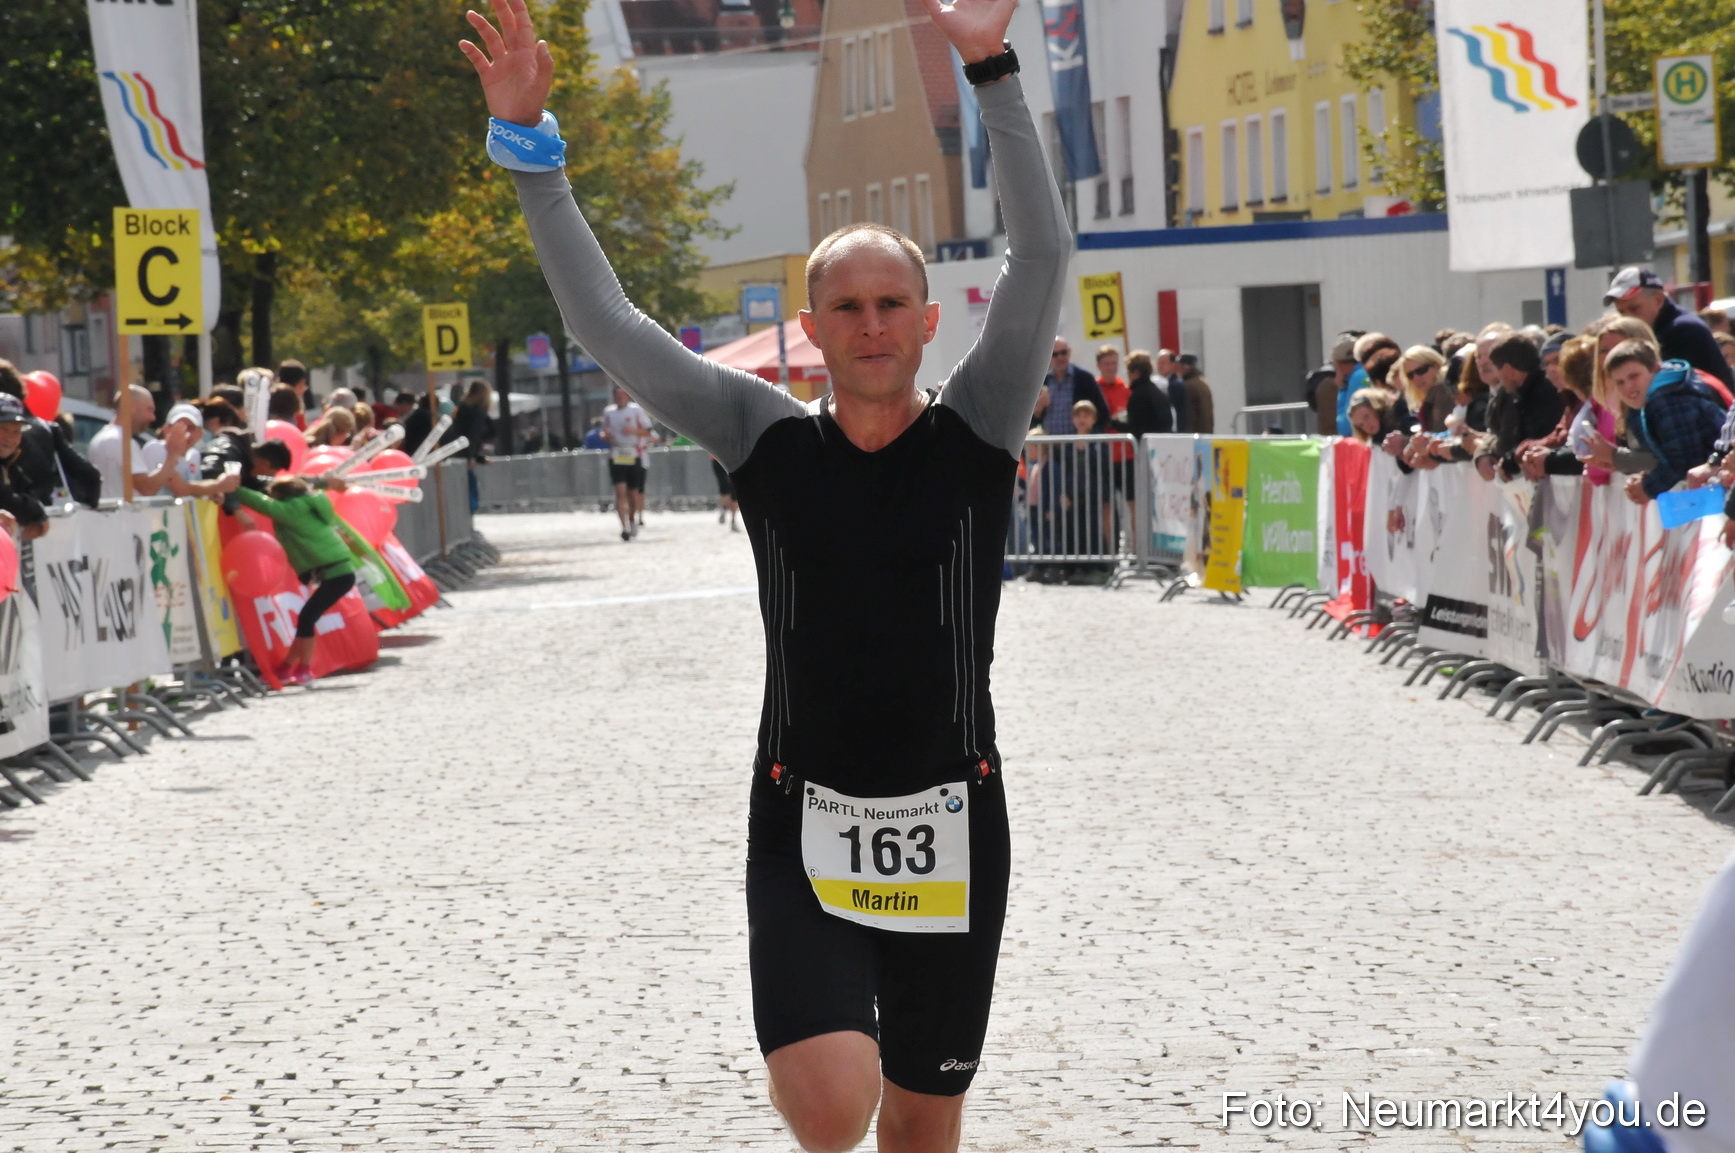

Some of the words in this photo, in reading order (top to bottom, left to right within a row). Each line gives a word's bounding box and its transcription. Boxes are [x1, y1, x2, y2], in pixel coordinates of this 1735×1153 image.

[1674, 71, 1697, 95] H
[125, 213, 191, 236] Block
[137, 246, 180, 307] C
[1083, 276, 1119, 290] Block
[1092, 293, 1115, 325] D
[436, 324, 460, 355] D
[808, 796, 861, 818] PARTL
[864, 802, 940, 820] Neumarkt
[839, 824, 936, 876] 163
[852, 888, 919, 911] Martin
